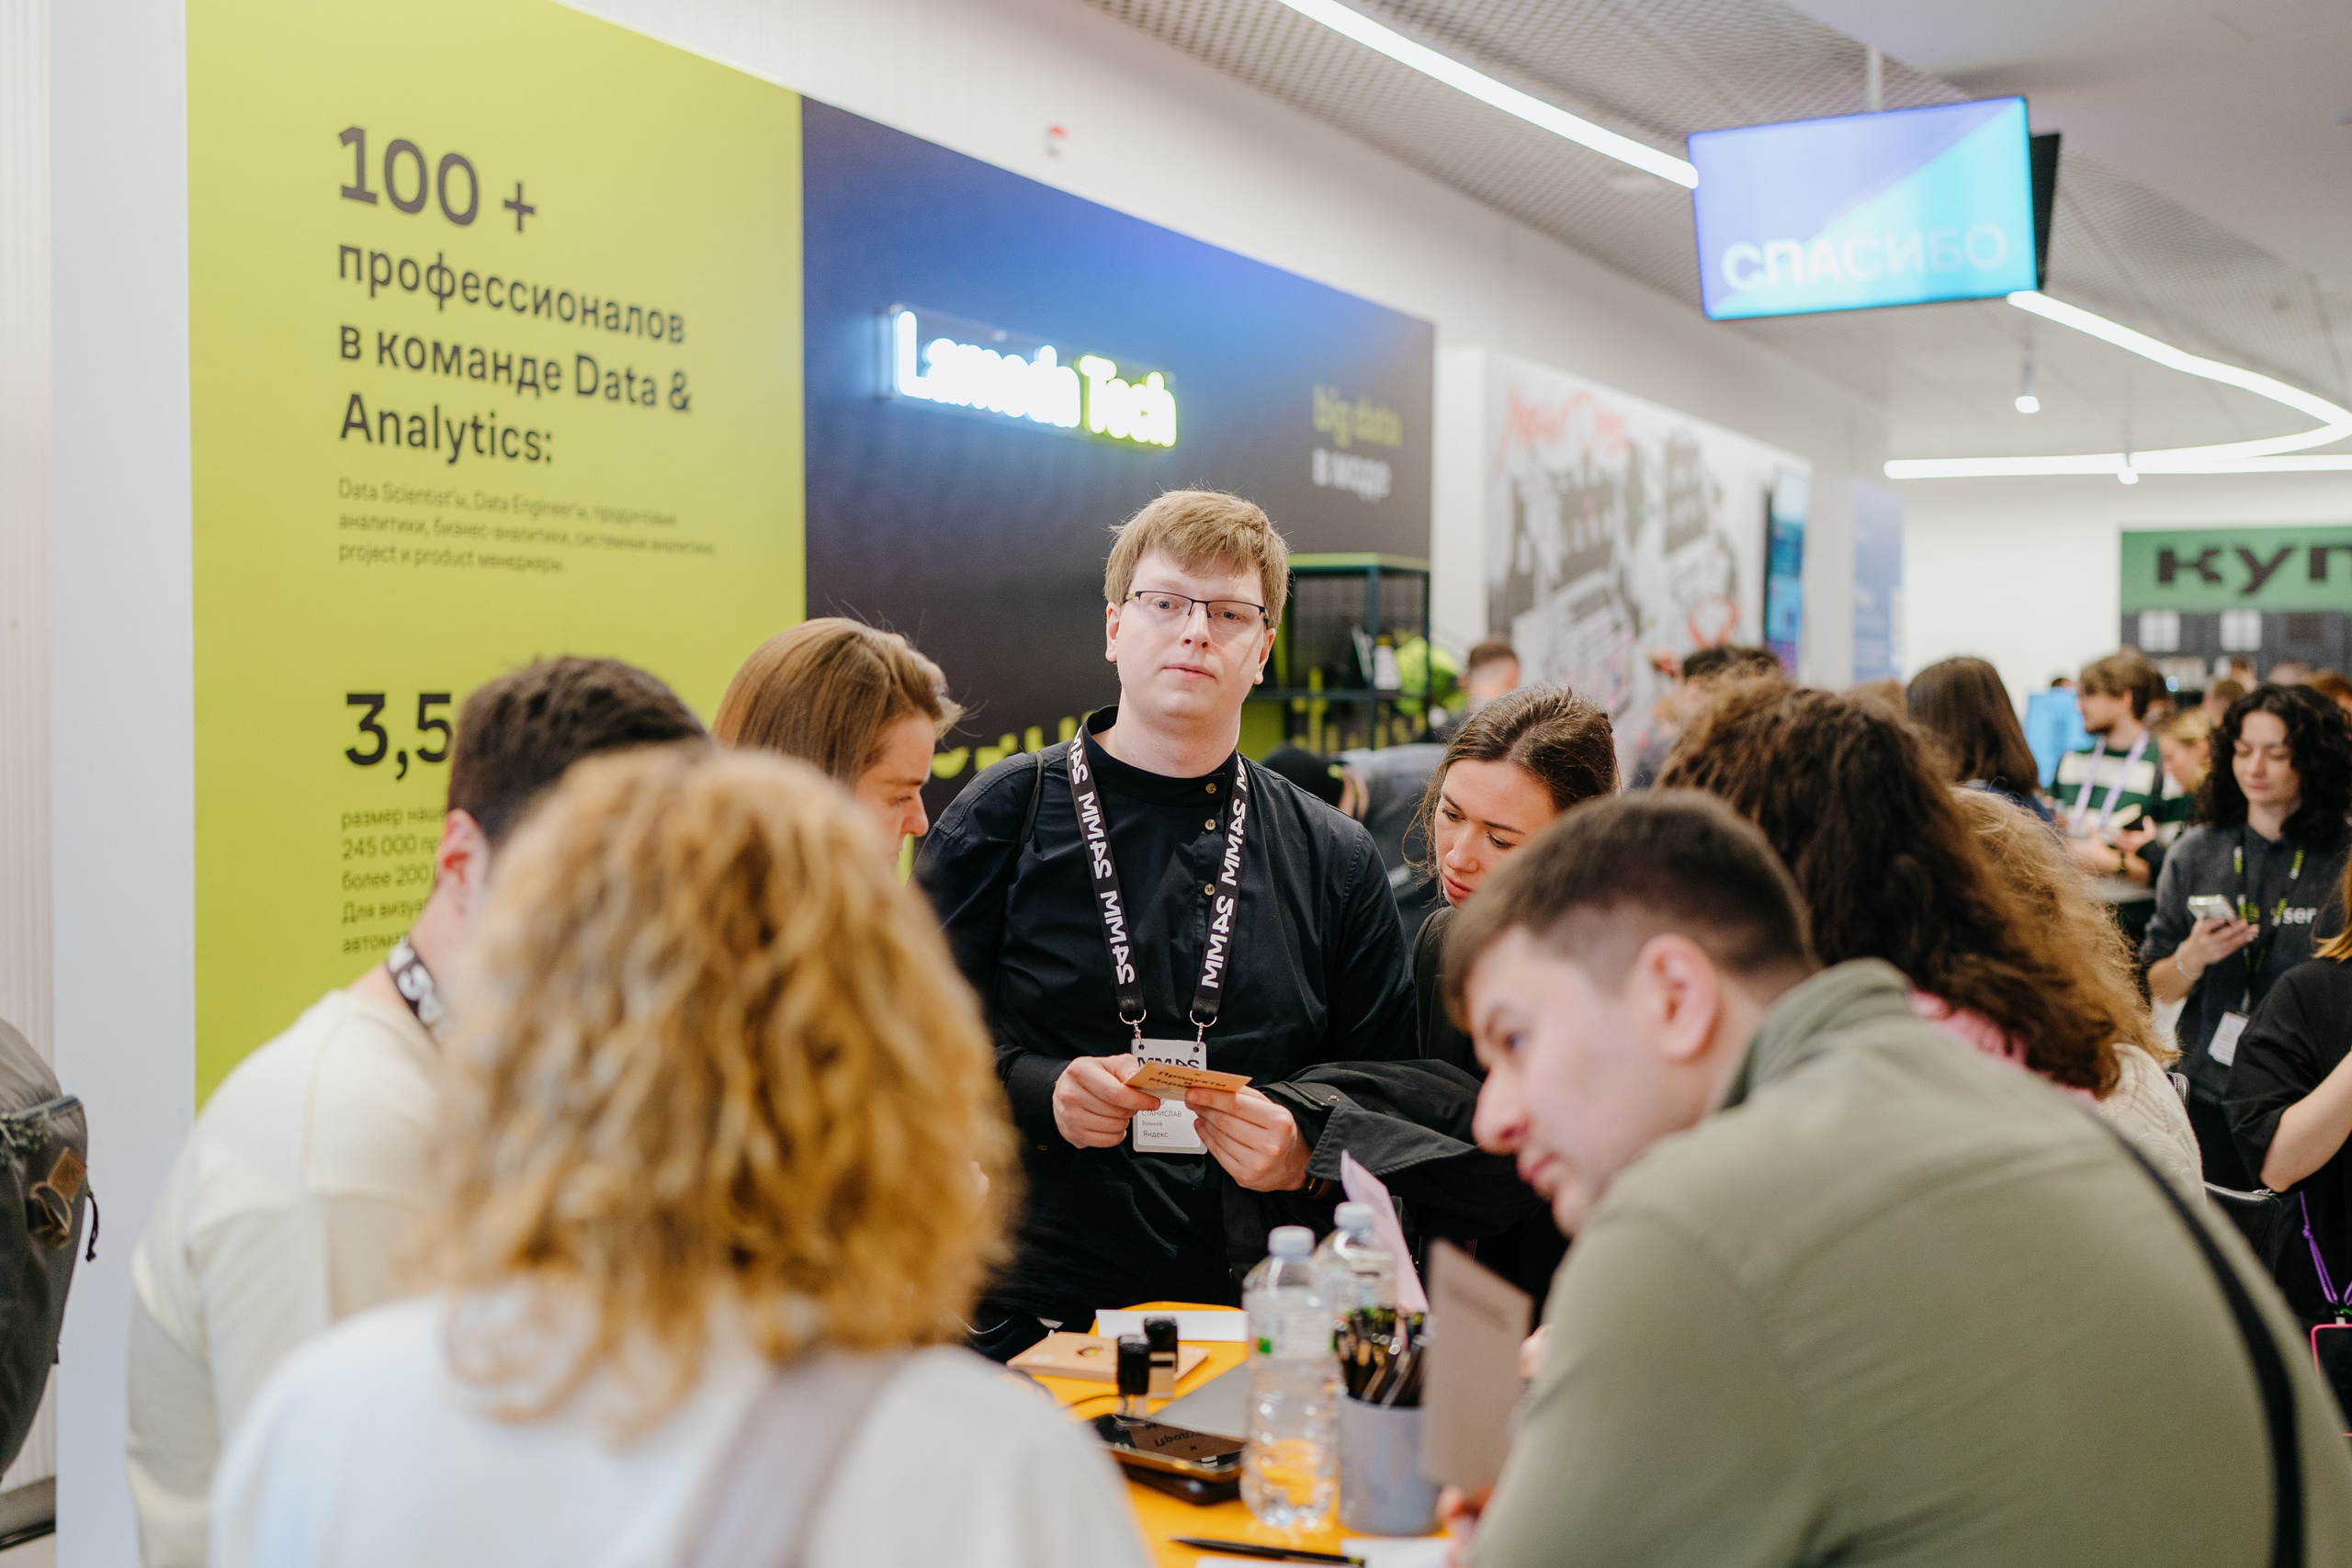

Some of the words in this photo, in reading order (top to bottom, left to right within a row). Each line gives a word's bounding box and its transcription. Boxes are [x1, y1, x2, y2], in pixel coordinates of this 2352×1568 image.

[338, 126, 479, 227] 100
[503, 183, 535, 232] +
[1722, 222, 2007, 291] СПАСИБО
[339, 244, 684, 344] профессионалов
[340, 325, 361, 360] в
[378, 331, 562, 398] команде
[576, 355, 657, 407] Data
[669, 370, 692, 412] &
[340, 393, 553, 465] Analytics:
[338, 476, 379, 502] Data
[345, 693, 454, 781] 3,5
[342, 808, 404, 832] размер
[342, 836, 378, 861] 245
[380, 833, 418, 857] 000
[342, 870, 391, 893] более
[395, 862, 430, 887] 200
[1159, 1071, 1227, 1087] Продукты
[1143, 1130, 1168, 1138] Яндекс
